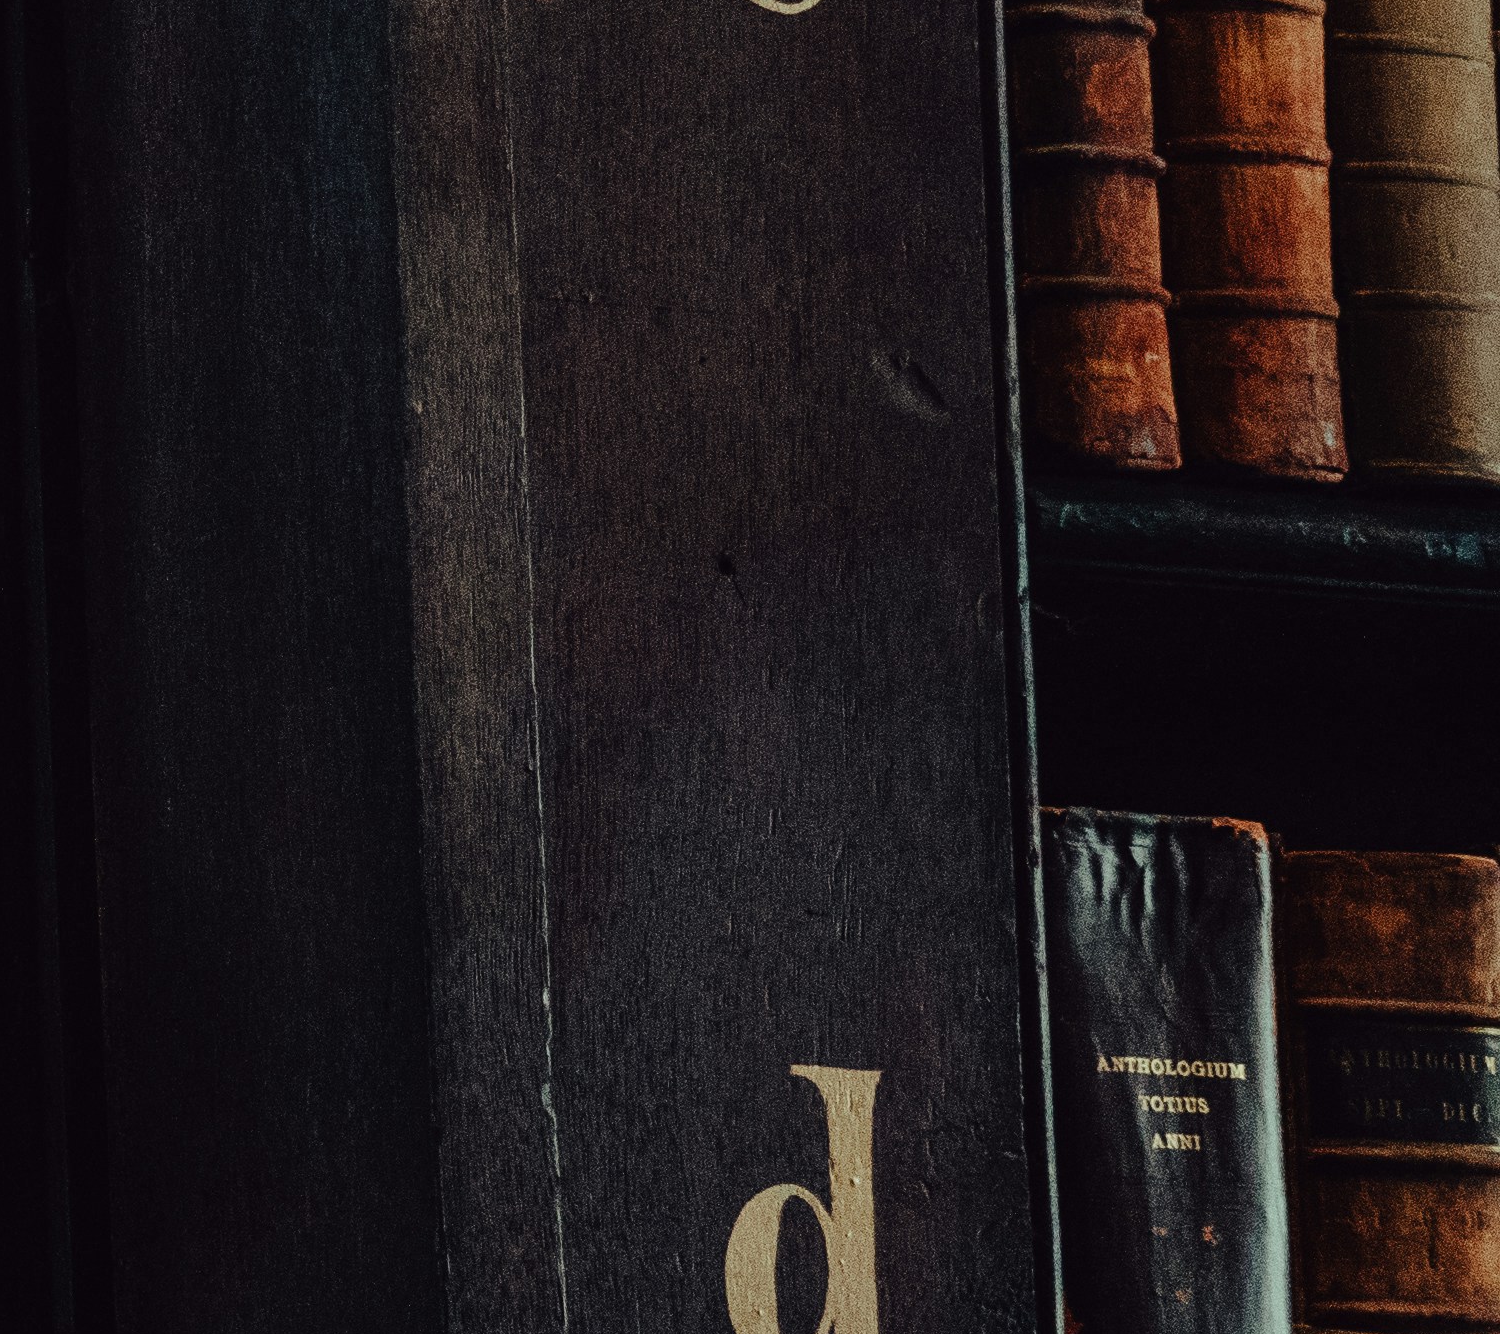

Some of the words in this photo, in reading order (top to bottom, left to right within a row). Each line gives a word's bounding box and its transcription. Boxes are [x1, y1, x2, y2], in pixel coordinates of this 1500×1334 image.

[1096, 1053, 1247, 1081] ANTHOLOGIUM
[1138, 1094, 1211, 1116] TOTIUS
[1152, 1133, 1202, 1152] ANNI
